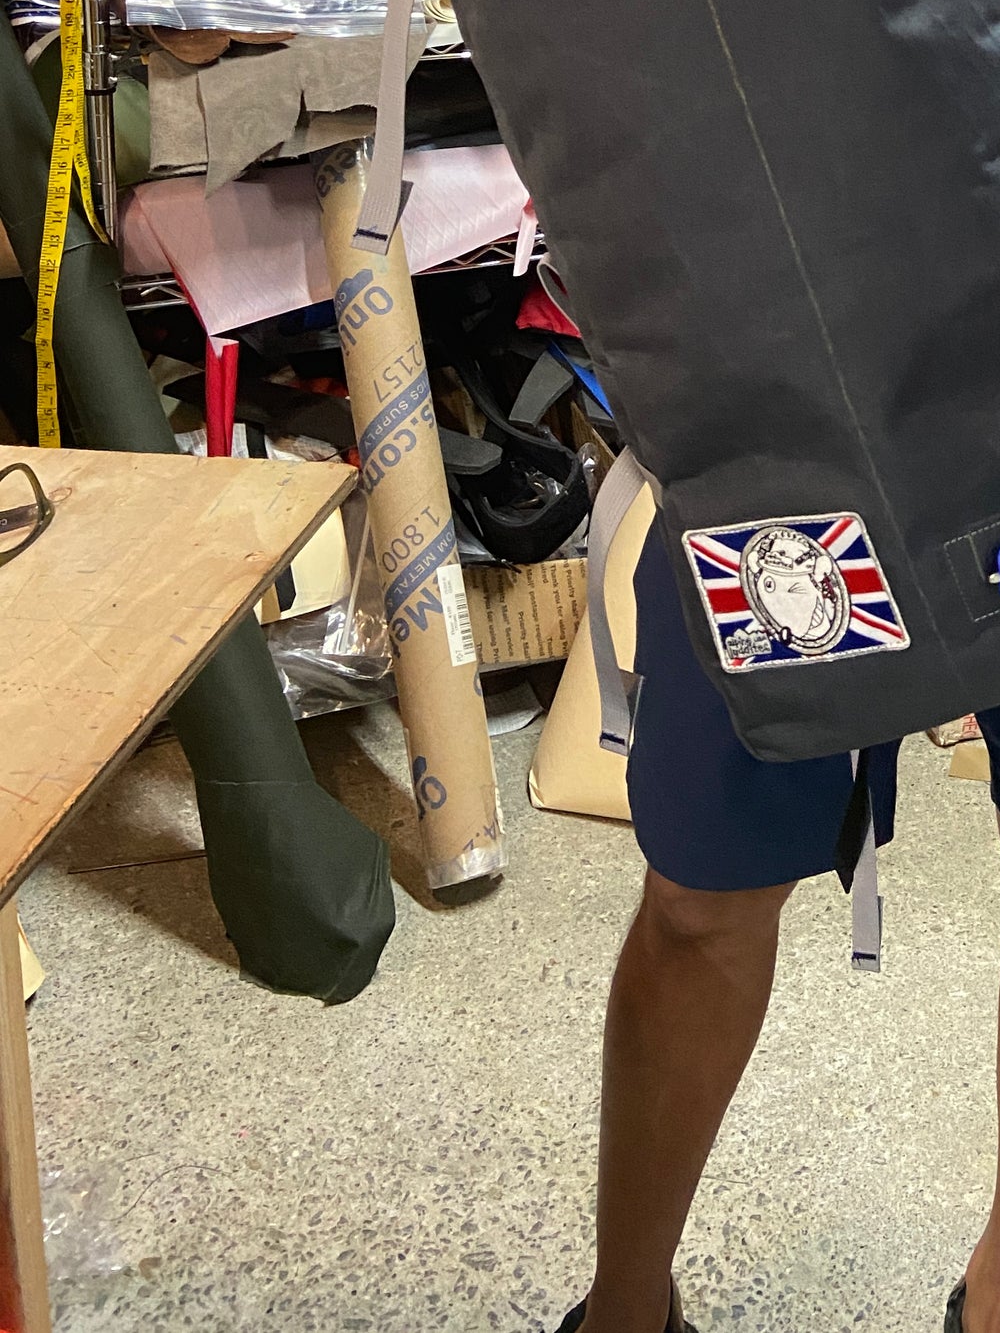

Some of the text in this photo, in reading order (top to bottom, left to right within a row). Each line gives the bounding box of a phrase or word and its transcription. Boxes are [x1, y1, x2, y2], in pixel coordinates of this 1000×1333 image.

[65, 89, 74, 103] 19
[62, 113, 73, 127] 18
[60, 136, 71, 151] 17
[57, 161, 68, 176] 16
[55, 185, 66, 200] 15
[52, 210, 64, 224] 14
[49, 234, 61, 248] 13
[46, 259, 57, 273] 12
[44, 284, 54, 297] 11
[364, 399, 410, 450] SUPPLY
[393, 552, 437, 596] METAL
